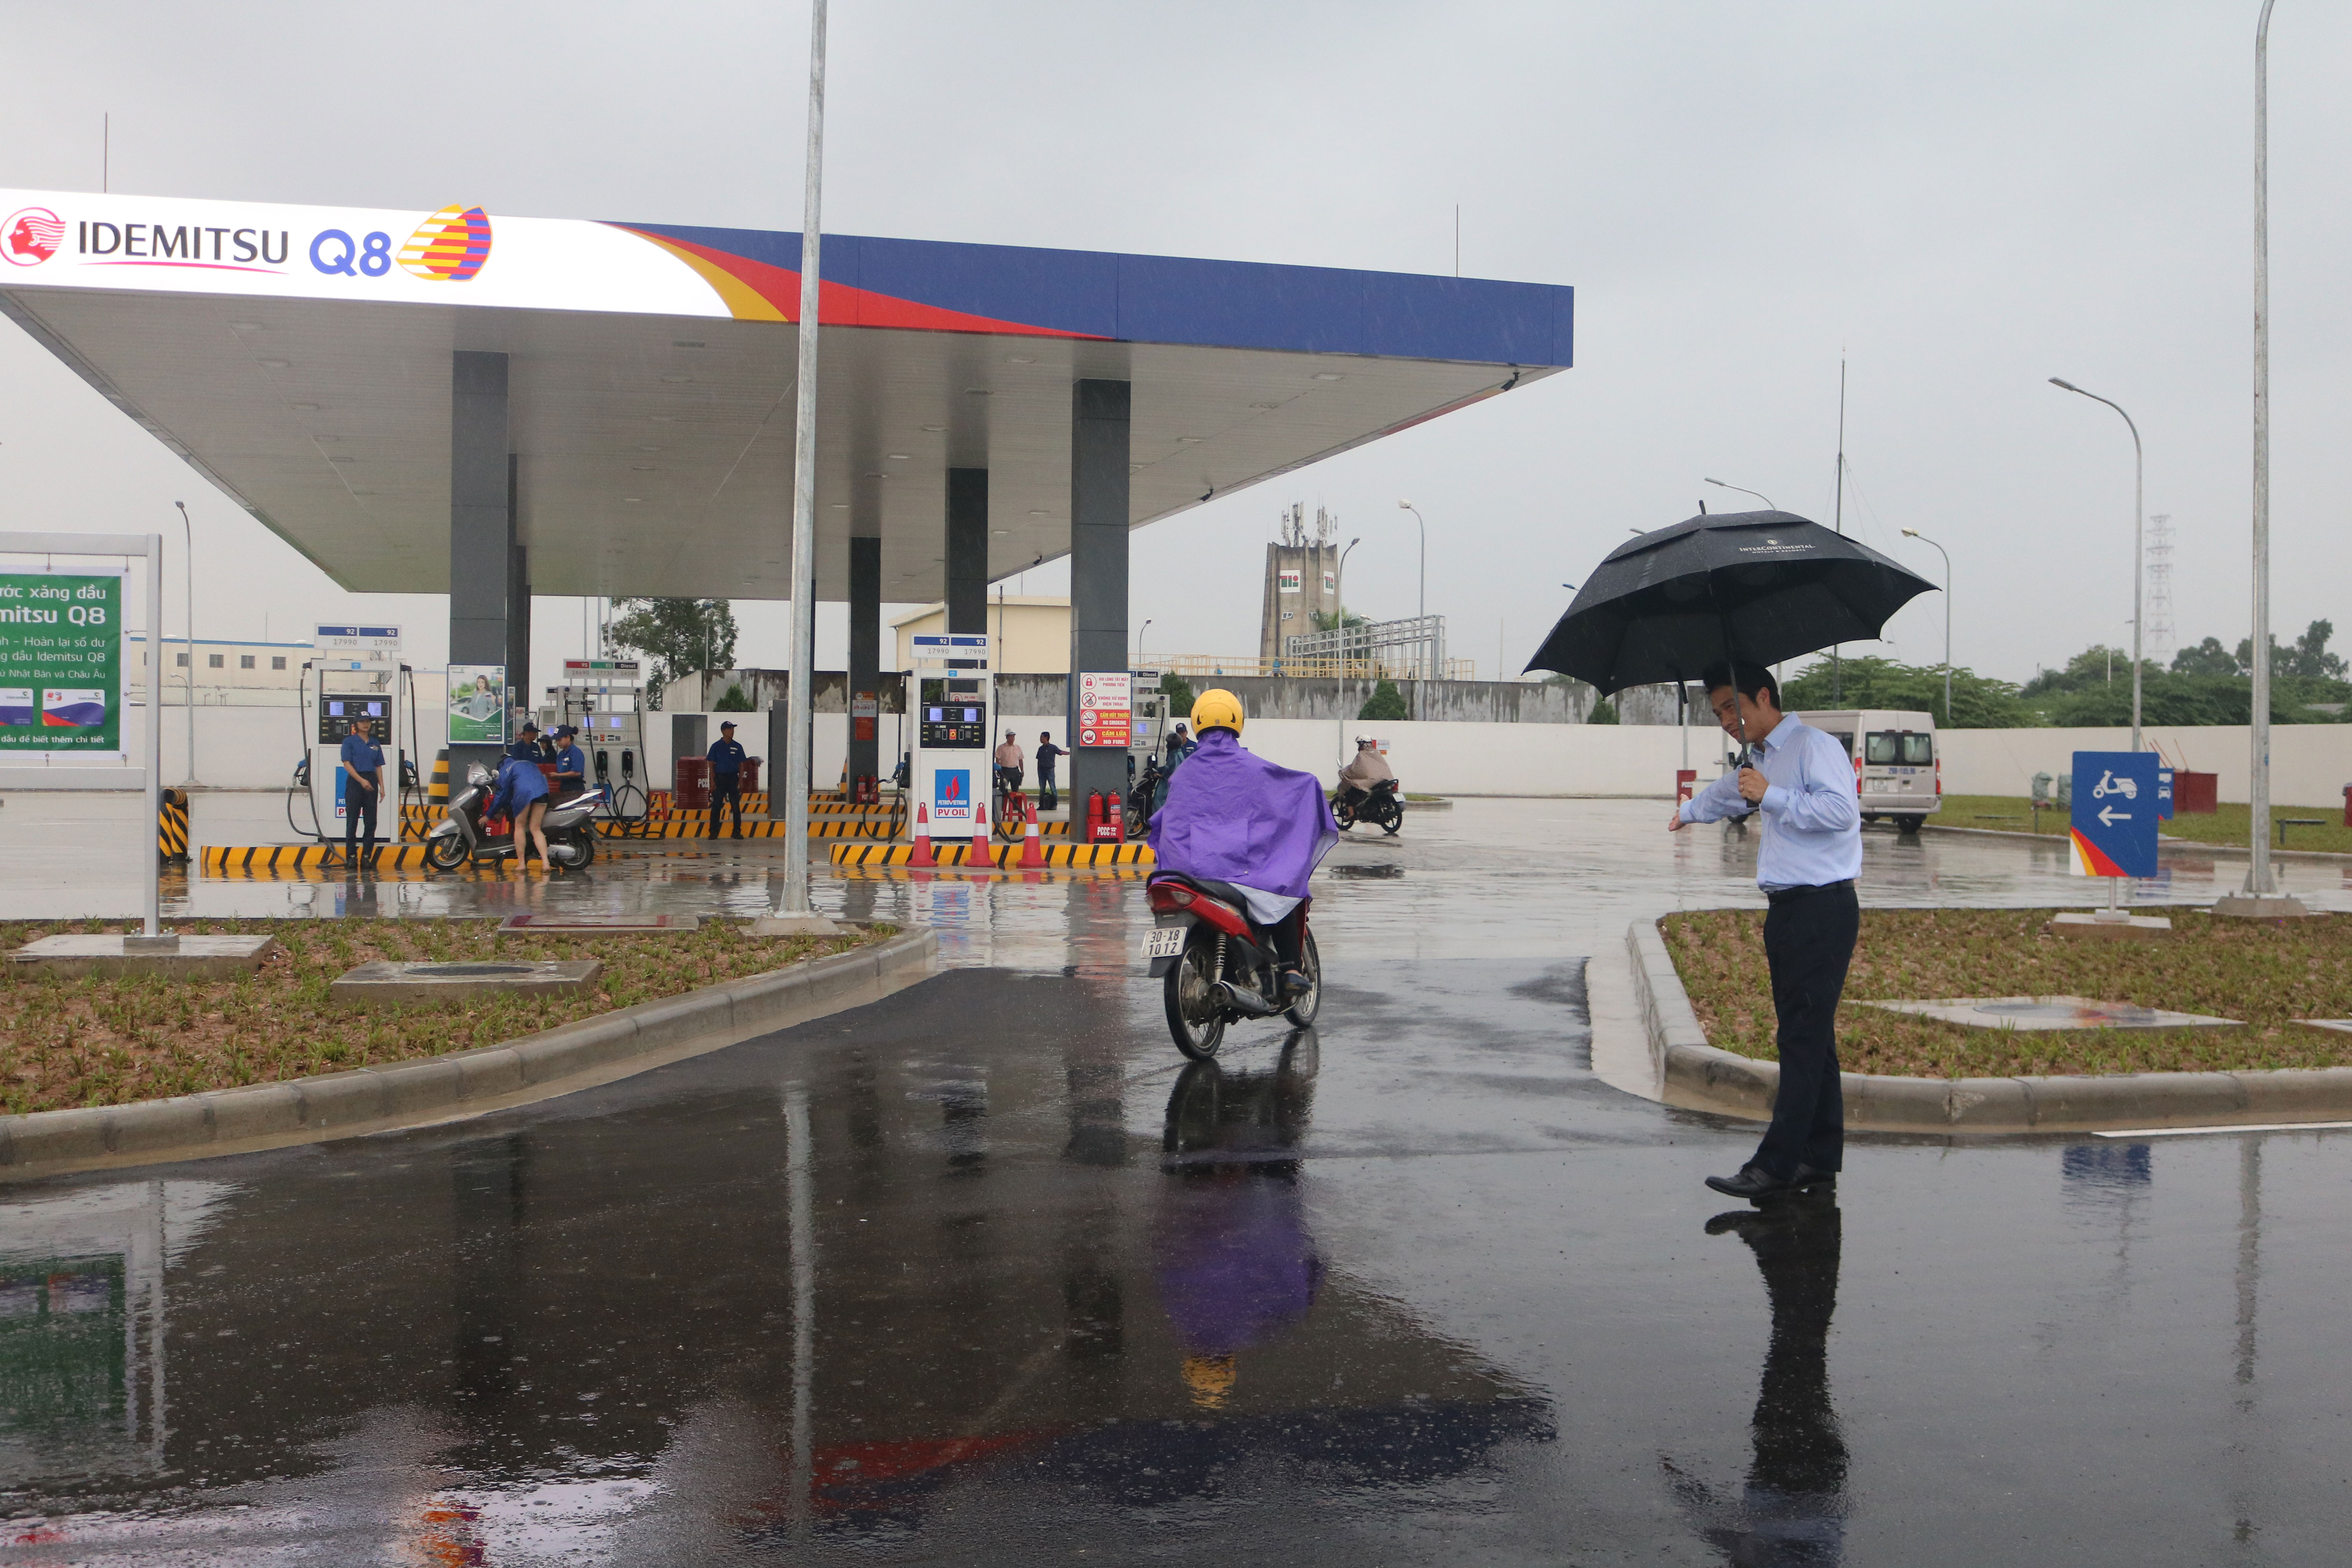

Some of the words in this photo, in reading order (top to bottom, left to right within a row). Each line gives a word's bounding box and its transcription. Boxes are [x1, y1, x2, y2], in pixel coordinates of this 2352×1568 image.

[79, 221, 289, 264] IDEMITSU
[309, 229, 392, 277] Q8
[29, 585, 70, 601] xăng
[76, 584, 106, 599] dầu
[68, 606, 105, 626] Q8
[25, 637, 54, 646] Hoàn
[59, 637, 70, 648] lại
[74, 636, 87, 647] số
[91, 638, 105, 647] dư
[12, 650, 32, 661] dầu
[37, 651, 83, 661] Idemitsu
[87, 652, 105, 663] Q8
[9, 670, 31, 679] Nhật
[34, 670, 51, 678] Bản
[19, 734, 30, 743] để
[91, 735, 104, 743] tiết
[1097, 826, 1110, 836] PCCC
[1151, 930, 1180, 943] 30-X8
[1149, 942, 1177, 955] 1012
